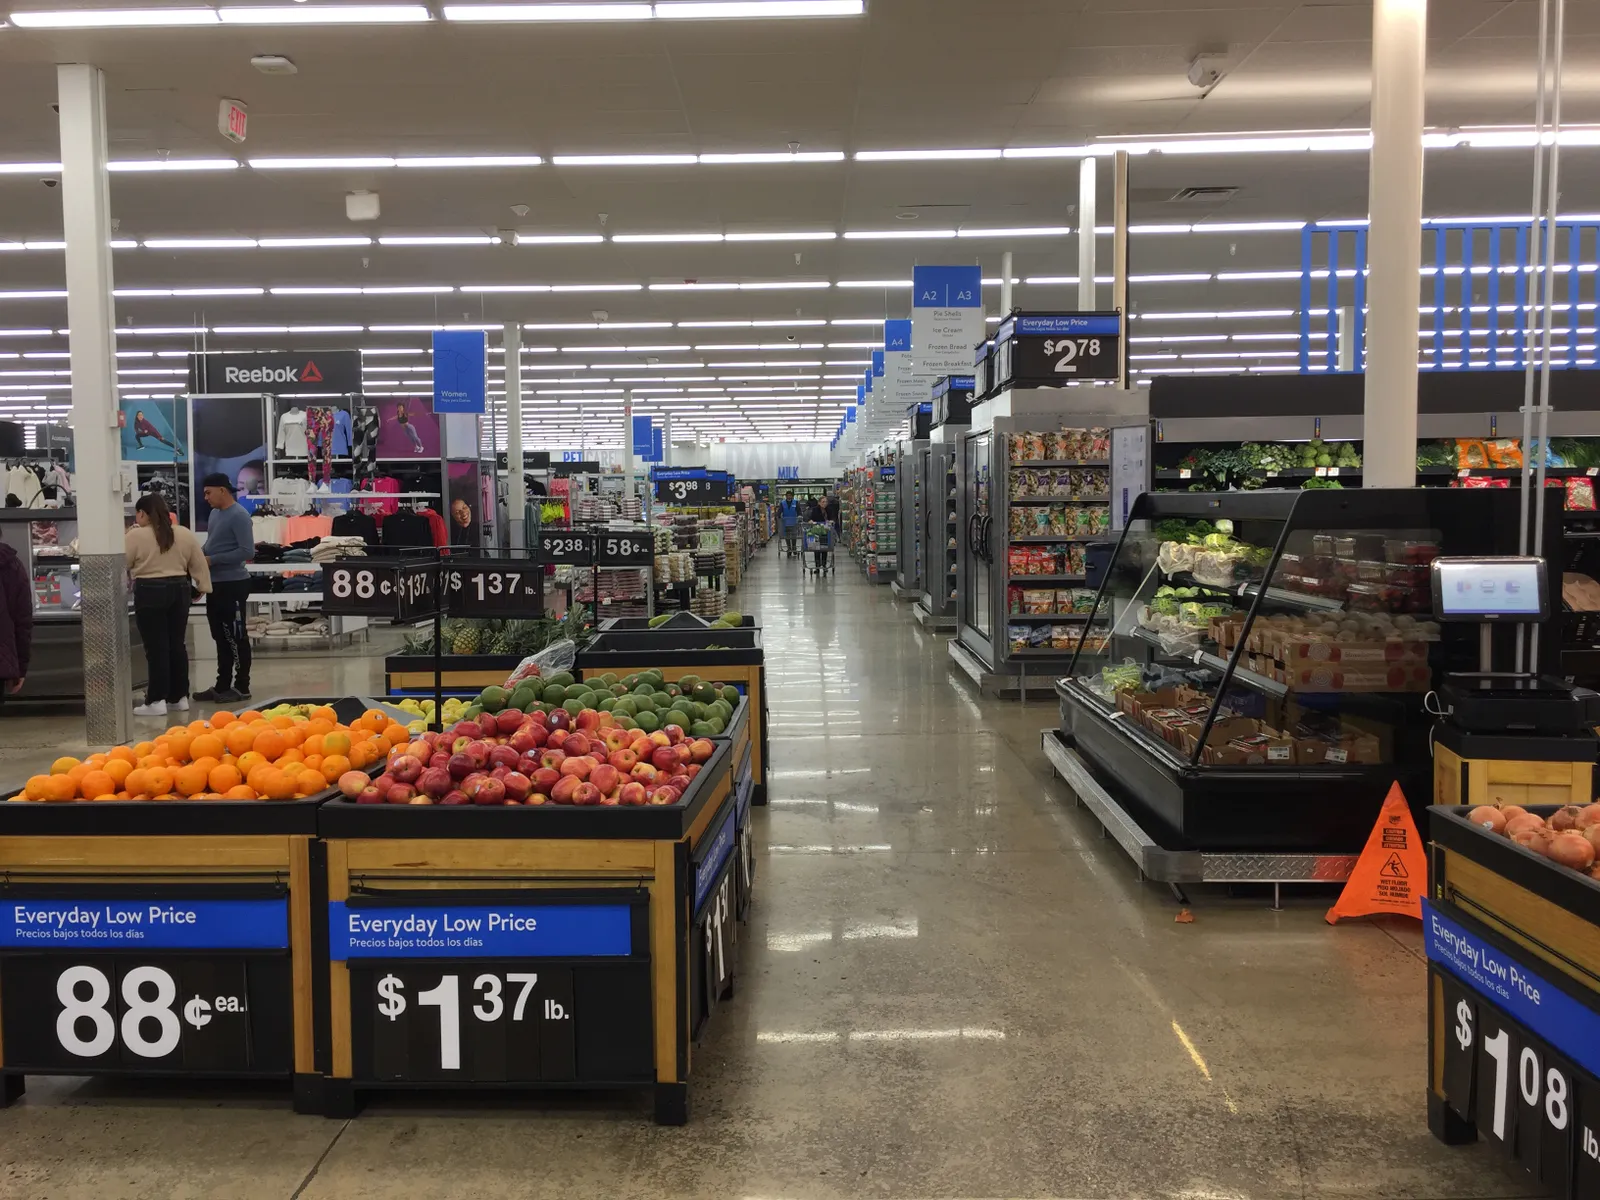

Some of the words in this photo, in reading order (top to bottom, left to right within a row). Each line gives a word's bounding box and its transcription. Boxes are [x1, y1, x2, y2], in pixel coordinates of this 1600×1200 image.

[230, 106, 246, 137] EXIT
[922, 290, 937, 300] A2
[957, 290, 972, 300] A3
[1022, 318, 1054, 328] Everyday
[1055, 319, 1070, 327] Low
[1070, 318, 1089, 327] Price
[891, 338, 904, 347] A4
[225, 366, 298, 383] Reebok
[563, 452, 583, 463] PET
[584, 451, 616, 465] CARE
[726, 443, 814, 479] DAIRY
[778, 466, 799, 479] MILK
[525, 586, 536, 595] lb.
[14, 906, 100, 928] Everyday
[106, 906, 142, 924] Low
[149, 906, 196, 924] Price
[349, 914, 437, 937] Everyday
[443, 914, 481, 931] Low
[488, 913, 537, 931] Price
[16, 928, 51, 938] Precios
[53, 928, 79, 940] bajos
[81, 928, 108, 938] todos
[109, 929, 123, 938] los
[125, 928, 144, 939] días
[349, 937, 386, 947] Precios
[388, 938, 414, 949] bajos
[416, 938, 445, 947] todos
[447, 937, 461, 947] los
[463, 937, 483, 947] días
[1431, 915, 1479, 968] Everyday
[1482, 949, 1507, 981] Low
[1510, 966, 1540, 1005] Price
[1434, 939, 1453, 959] Precios
[1453, 954, 1467, 972] bajos
[1467, 965, 1485, 984] todos
[1485, 976, 1496, 991] los
[1496, 983, 1510, 1000] días
[215, 995, 245, 1012] ea.
[545, 1000, 569, 1020] lb.
